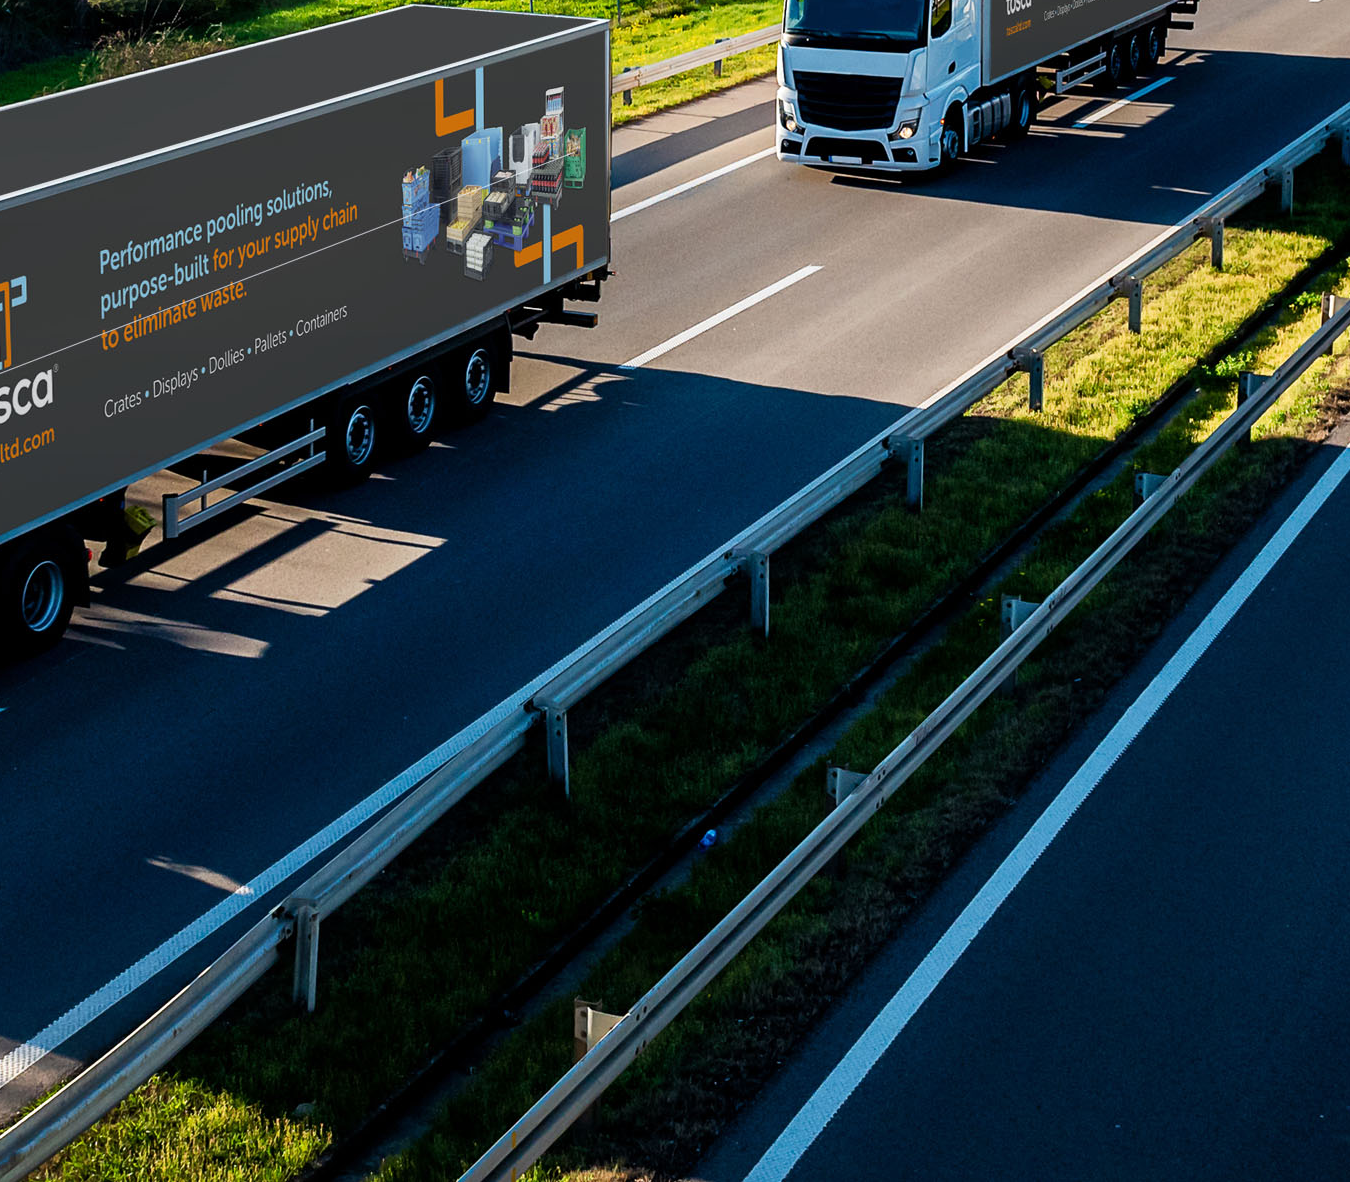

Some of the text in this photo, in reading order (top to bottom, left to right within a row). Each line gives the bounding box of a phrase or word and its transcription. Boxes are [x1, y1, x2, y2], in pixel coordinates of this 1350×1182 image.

[99, 179, 333, 275] Performance pooling solutions,
[100, 201, 359, 320] purpose-built for your supply chain
[100, 281, 248, 351] to eliminate waste.
[103, 304, 348, 419] Crates Displays Dollies Pallets Containers
